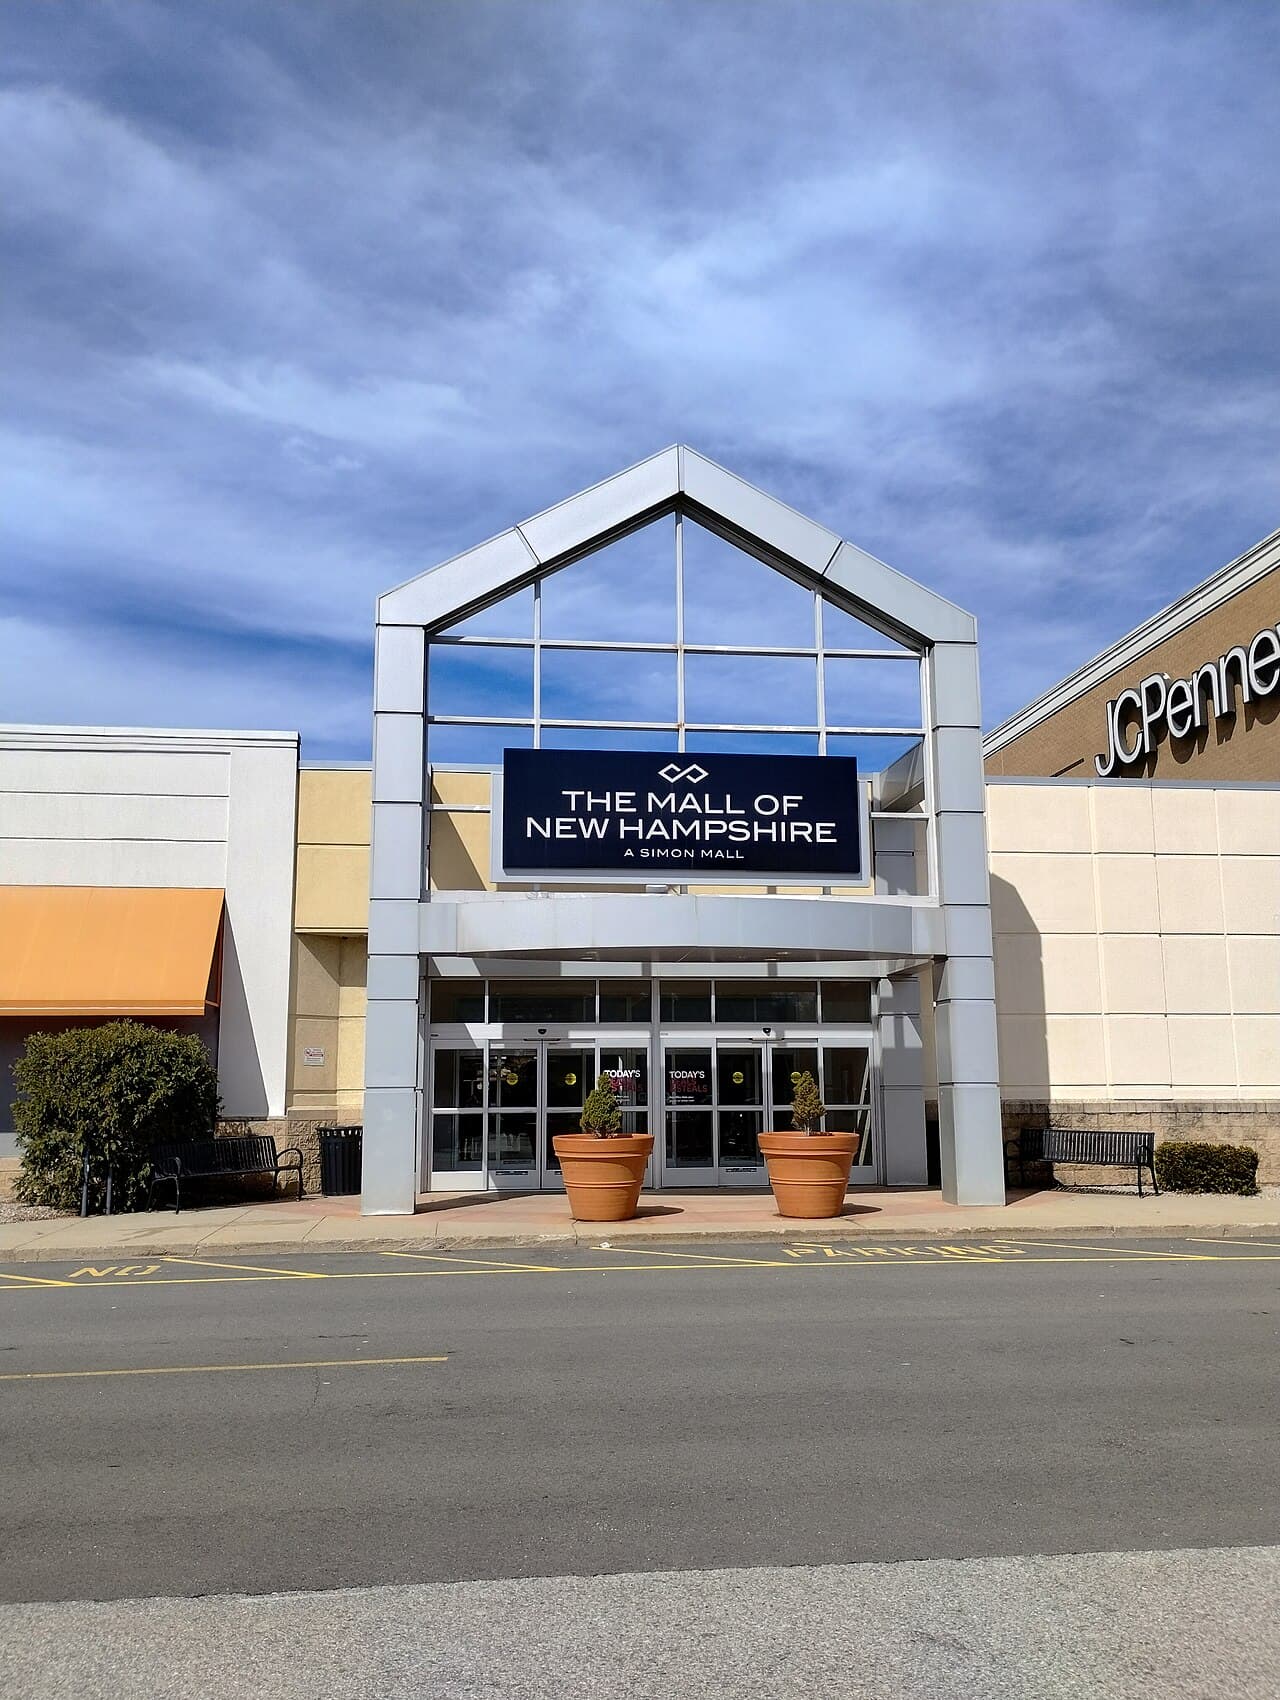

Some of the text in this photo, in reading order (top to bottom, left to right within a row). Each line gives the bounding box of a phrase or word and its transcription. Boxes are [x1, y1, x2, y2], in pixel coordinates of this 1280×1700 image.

[1094, 623, 1280, 777] JCPenne
[561, 790, 804, 816] THE MALL OF
[526, 816, 838, 843] NEW HAMPSHIRE
[623, 848, 745, 859] A SIMON MALL
[669, 1070, 705, 1079] TODAY'S
[781, 1245, 1025, 1257] PARKING
